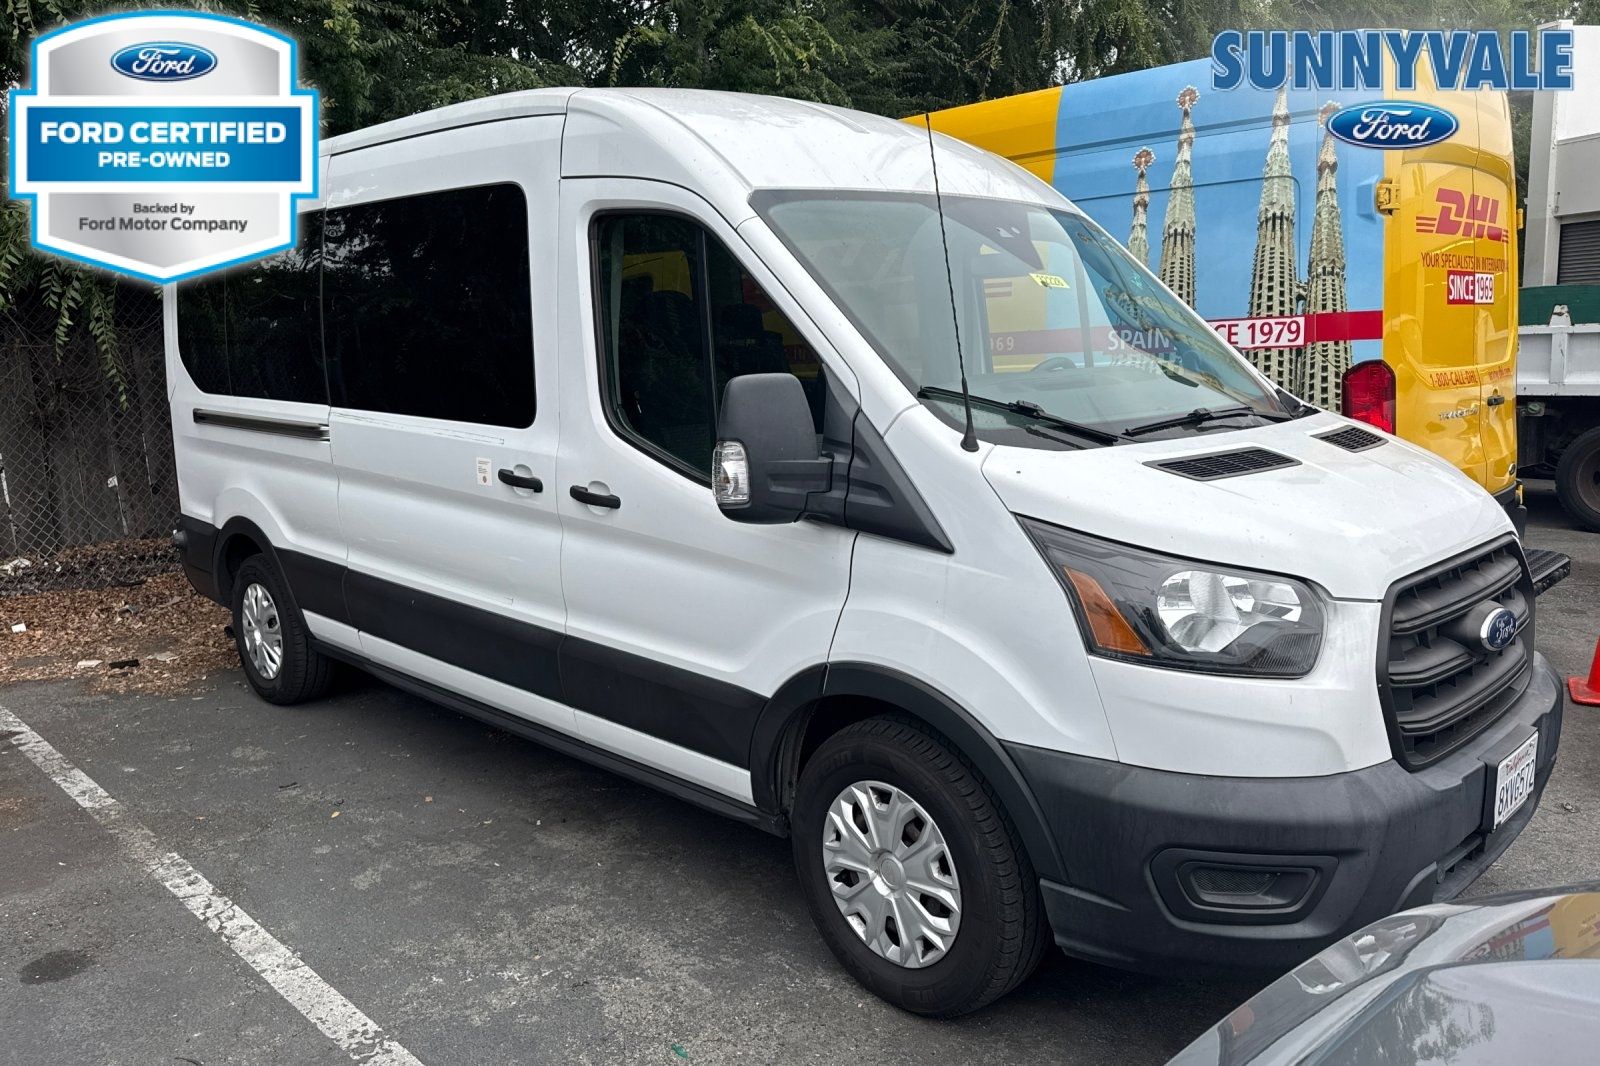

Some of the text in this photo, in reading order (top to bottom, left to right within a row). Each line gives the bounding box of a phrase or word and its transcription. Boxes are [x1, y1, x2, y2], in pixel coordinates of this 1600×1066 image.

[1435, 187, 1503, 242] DHL
[1421, 252, 1439, 267] YOUR
[1441, 253, 1474, 270] SPECIALISTS
[1448, 274, 1493, 300] SINCE 1969
[1108, 327, 1170, 350] SPAIN
[1210, 320, 1301, 345] CE 1979
[1498, 758, 1535, 817] 8XVG572
